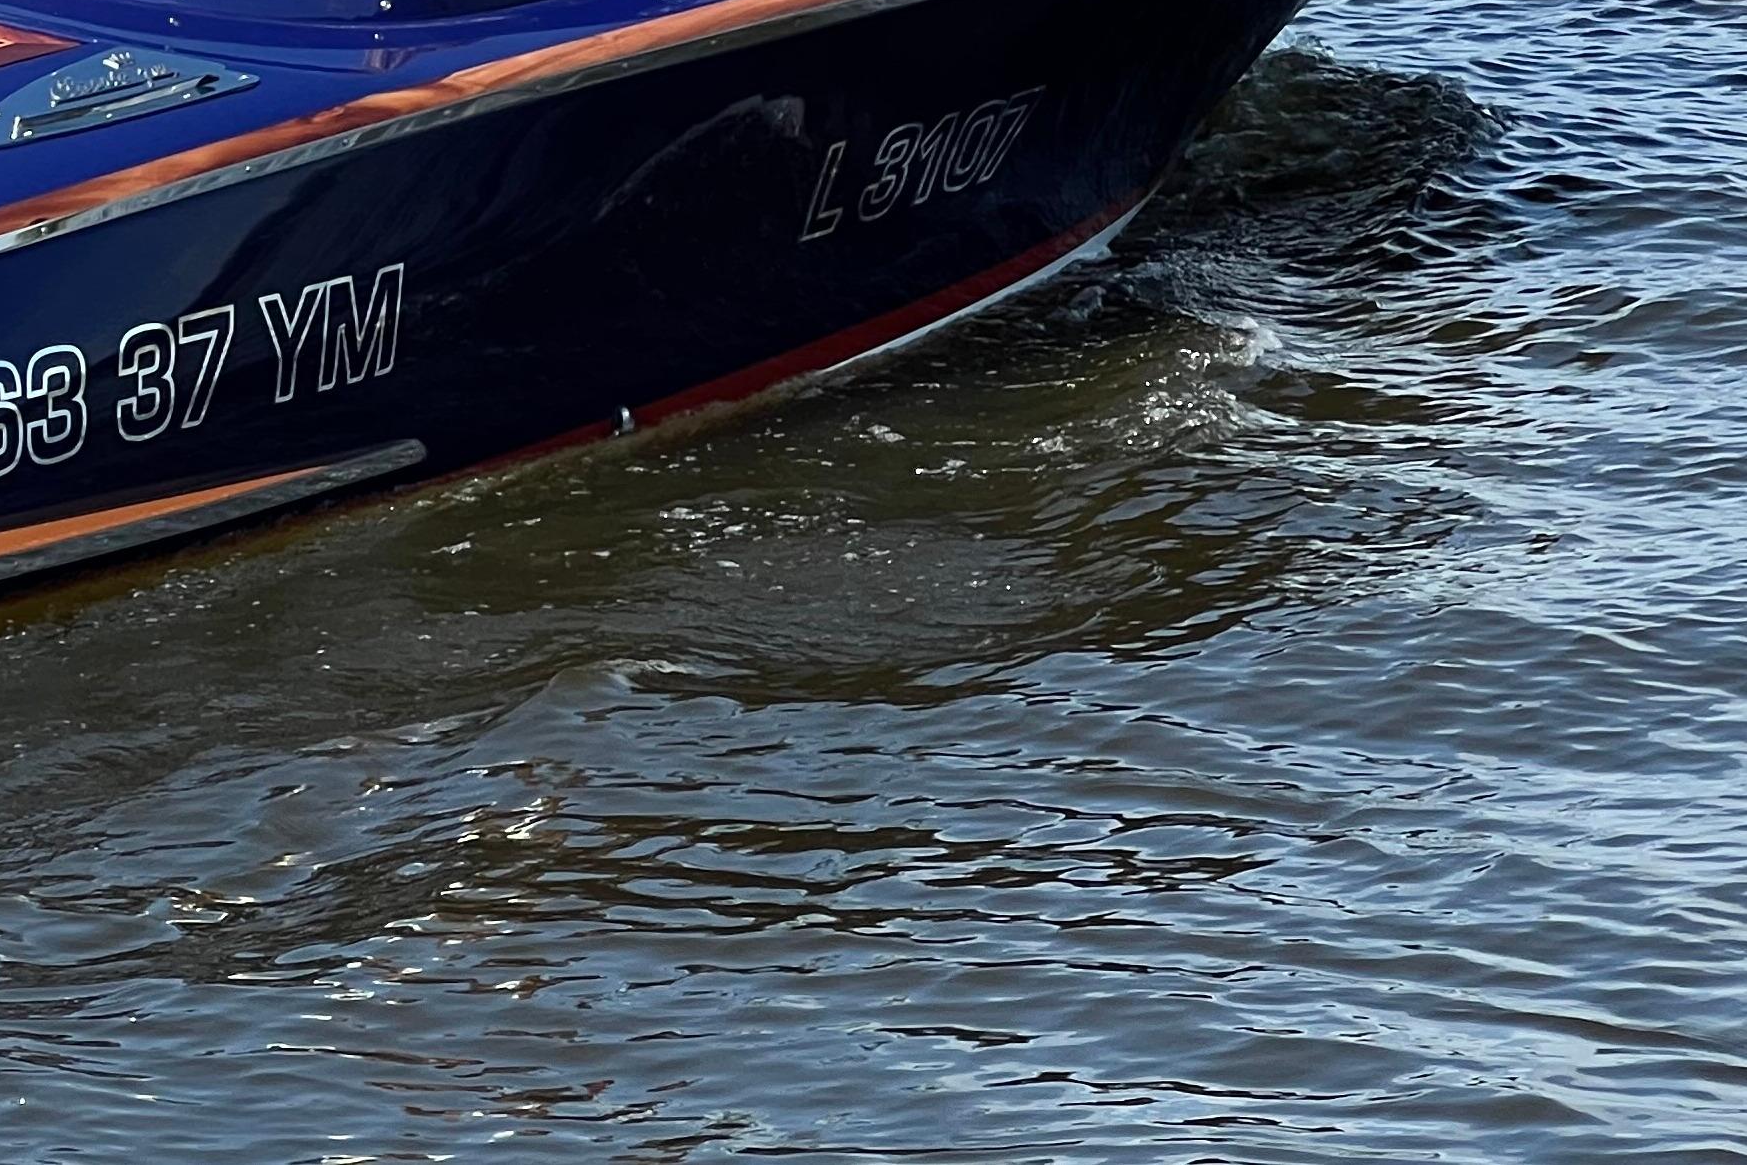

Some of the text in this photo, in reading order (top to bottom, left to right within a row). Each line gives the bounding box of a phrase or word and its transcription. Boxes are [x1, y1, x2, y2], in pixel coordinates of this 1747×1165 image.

[799, 85, 1047, 243] L 3107
[117, 304, 234, 441] 37
[258, 262, 404, 403] YM
